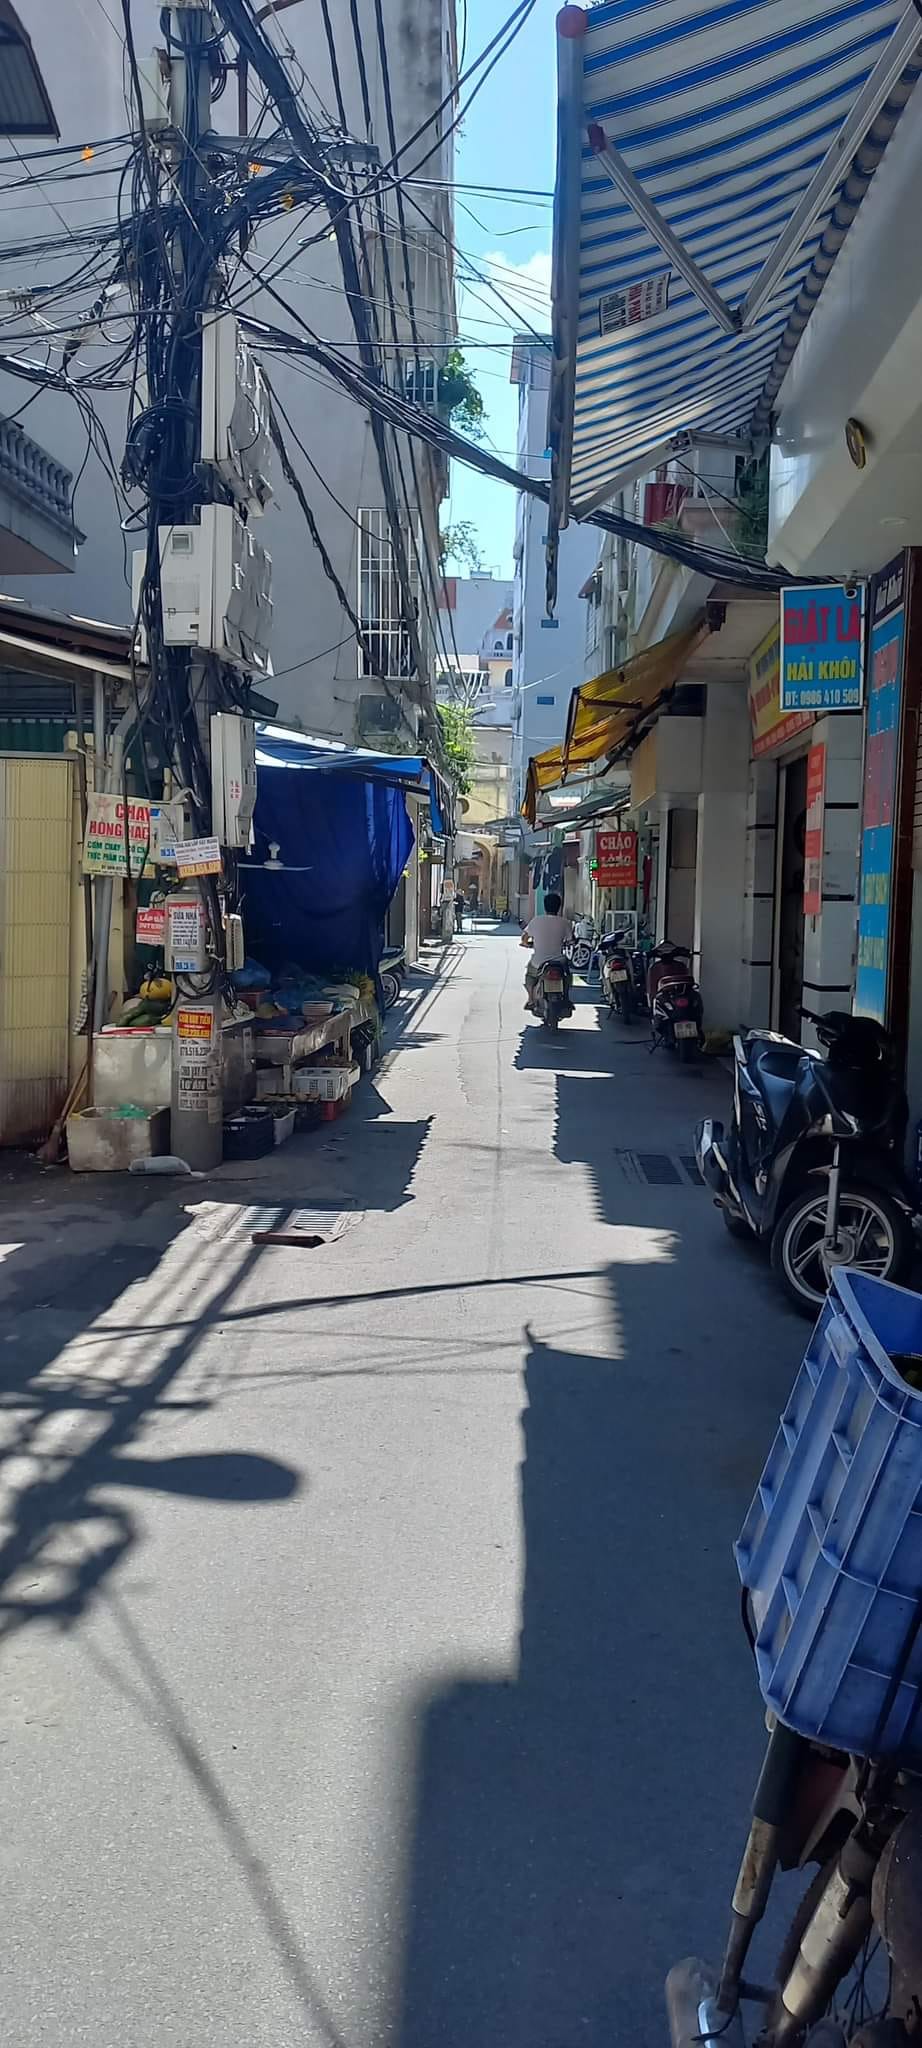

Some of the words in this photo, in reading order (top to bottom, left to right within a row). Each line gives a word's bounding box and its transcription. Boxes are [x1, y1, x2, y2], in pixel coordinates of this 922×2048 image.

[787, 656, 814, 680] HẢI
[818, 656, 856, 679] KHÔI
[800, 690, 822, 705] 0986
[824, 689, 841, 704] 410
[842, 688, 859, 703] 509
[600, 833, 632, 850] CHÁO
